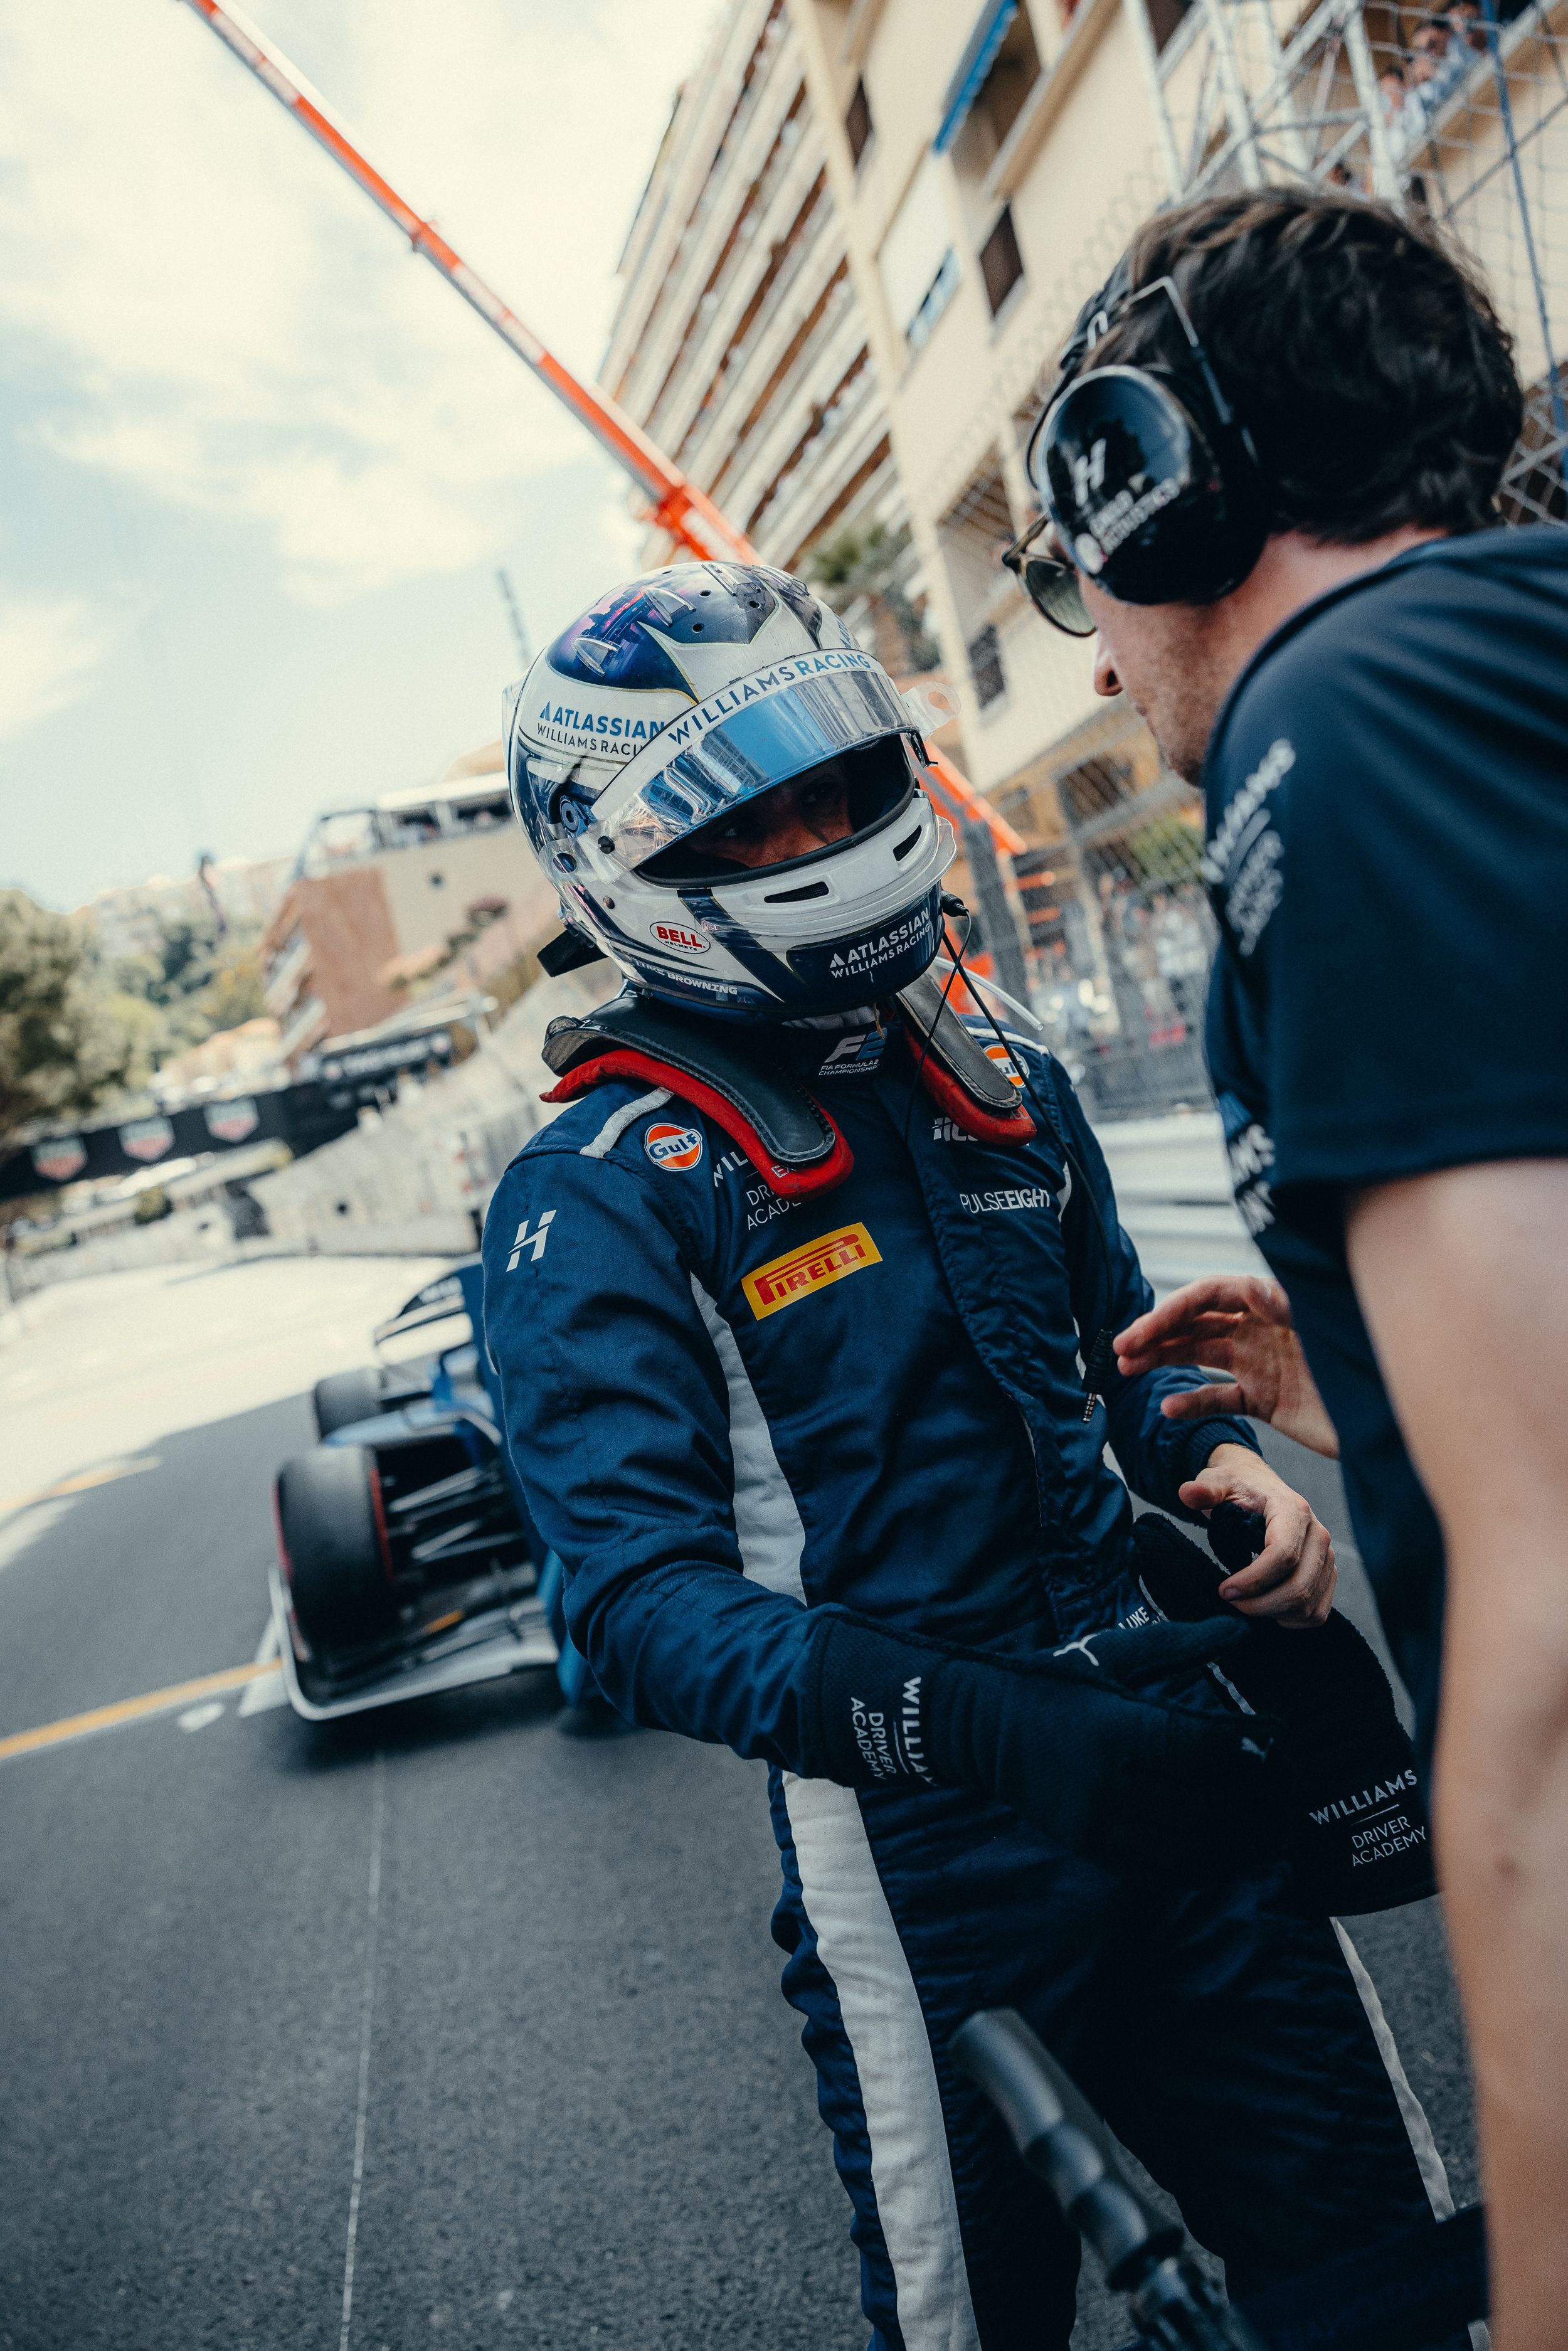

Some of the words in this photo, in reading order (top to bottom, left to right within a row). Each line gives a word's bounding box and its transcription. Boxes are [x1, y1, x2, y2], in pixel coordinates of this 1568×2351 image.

[667, 666, 795, 745] WILLIAMS
[794, 654, 871, 676] RACING
[538, 723, 596, 751] WILLIAMS
[600, 740, 645, 756] RACI
[552, 706, 665, 740] ATLASSIAN
[656, 926, 702, 948] BELL
[665, 940, 697, 951] HELMETS
[830, 949, 895, 979] WILLIAMS
[896, 922, 930, 955] RACING
[847, 907, 930, 963] ATLASSIAN
[667, 972, 738, 995] BROWNING
[818, 1065, 877, 1076] CHAMPIONSHIP
[649, 1132, 697, 1159] Gulf
[753, 1233, 866, 1306] PIRELLI
[850, 1697, 887, 1780] ACADEMY
[868, 1712, 897, 1774] DRIVER
[1309, 1769, 1417, 1825] WILLIAMS
[1352, 1816, 1411, 1849] DRIVER
[1352, 1826, 1426, 1867] ACADEMY
